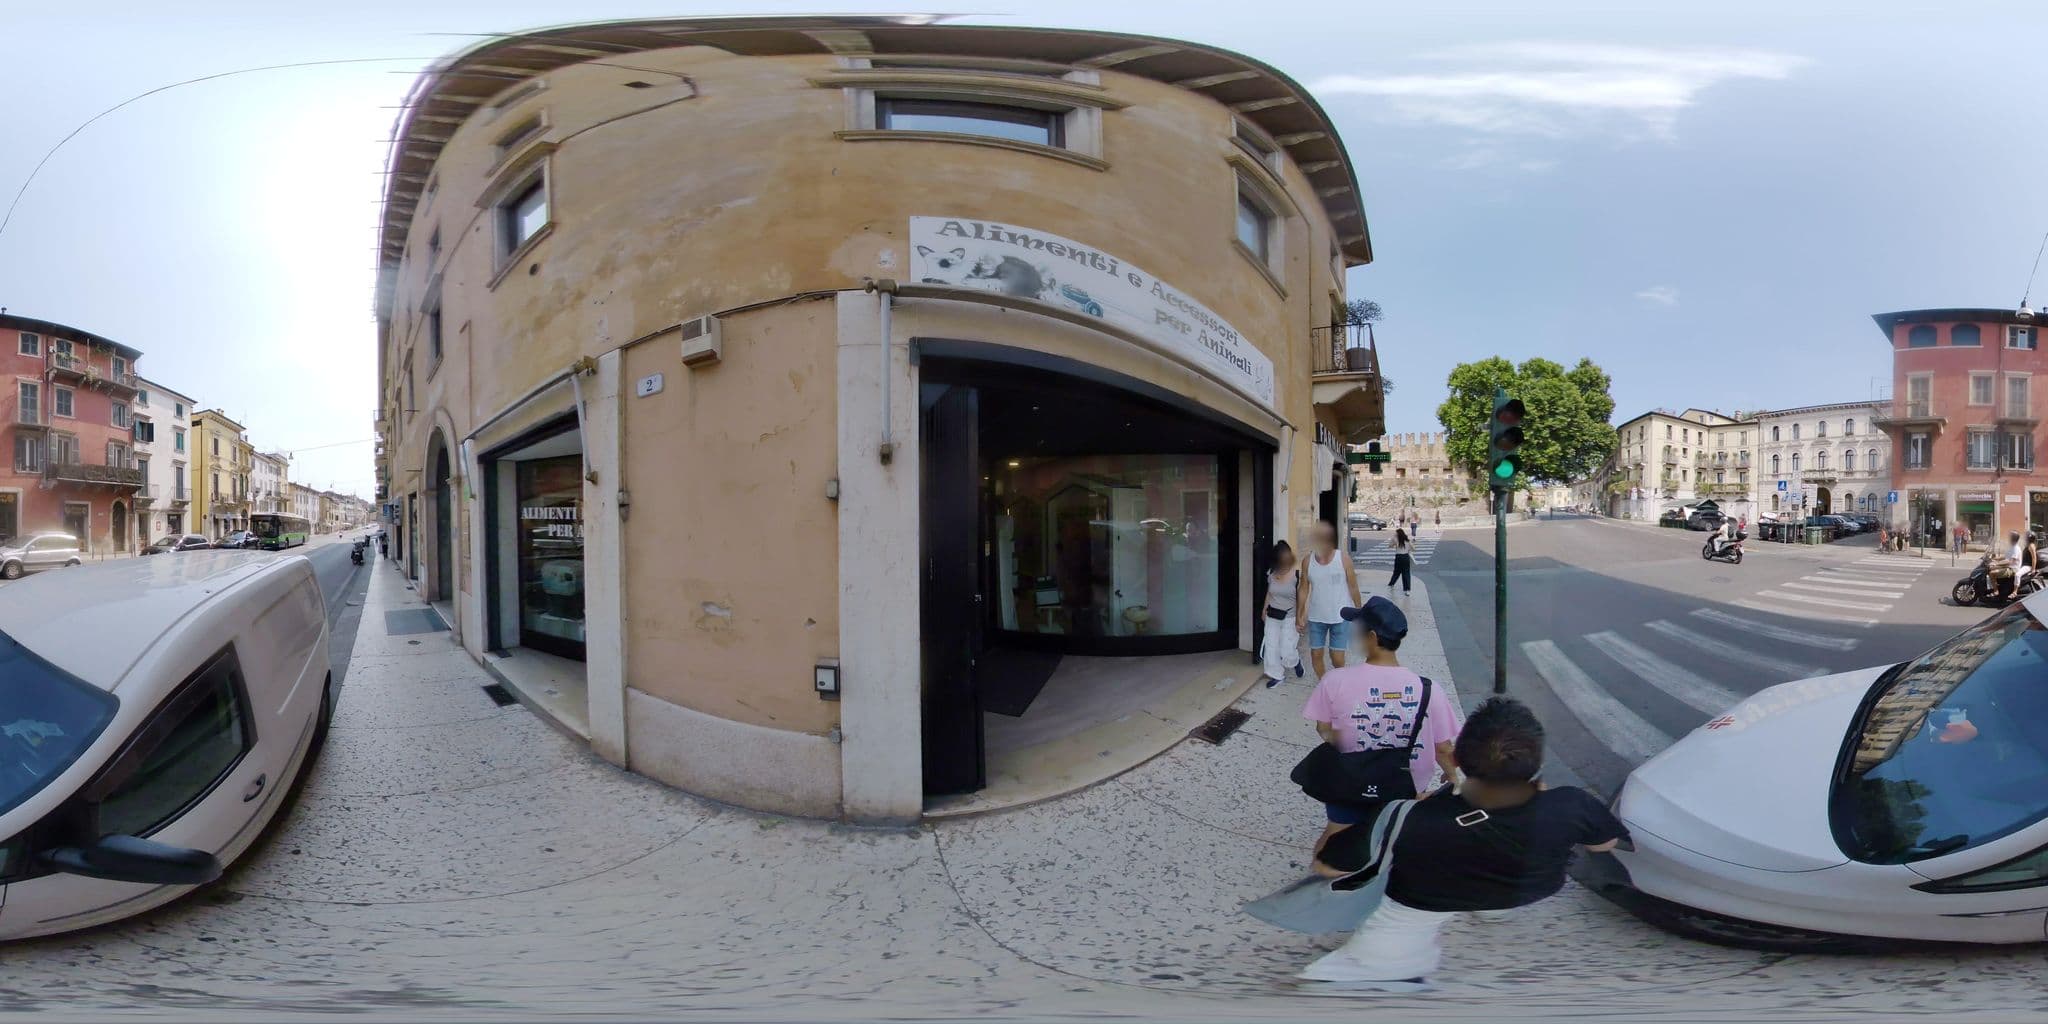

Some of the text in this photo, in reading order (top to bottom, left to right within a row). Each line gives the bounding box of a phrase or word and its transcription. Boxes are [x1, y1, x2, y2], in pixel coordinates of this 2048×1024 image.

[936, 220, 1239, 347] Alimenti e Accessori
[1154, 308, 1253, 376] per Animali
[646, 379, 653, 392] 2
[520, 506, 577, 520] ALIMENTI
[548, 524, 574, 537] PER
